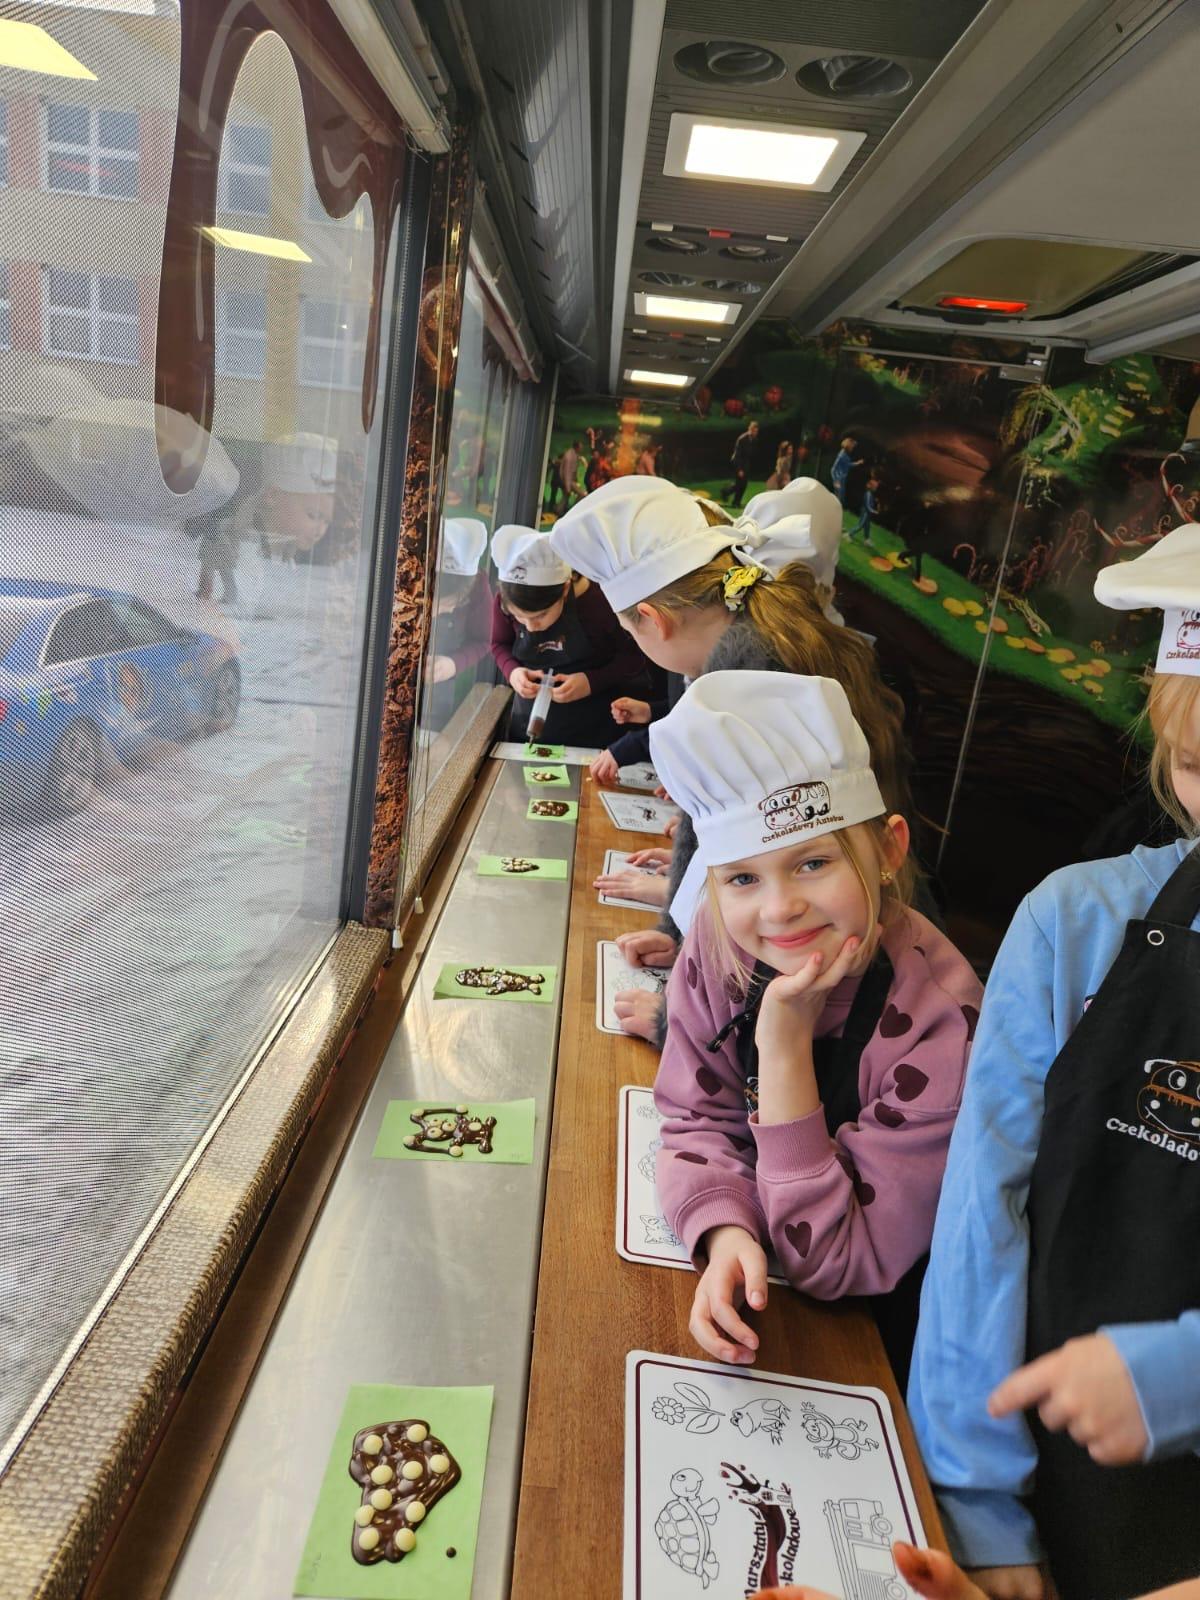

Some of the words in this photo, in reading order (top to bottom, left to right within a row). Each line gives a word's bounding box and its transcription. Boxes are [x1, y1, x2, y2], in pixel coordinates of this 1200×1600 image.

[1165, 648, 1200, 660] Czekolad
[1106, 1117, 1200, 1162] Czekolado
[779, 1508, 801, 1587] koladowe
